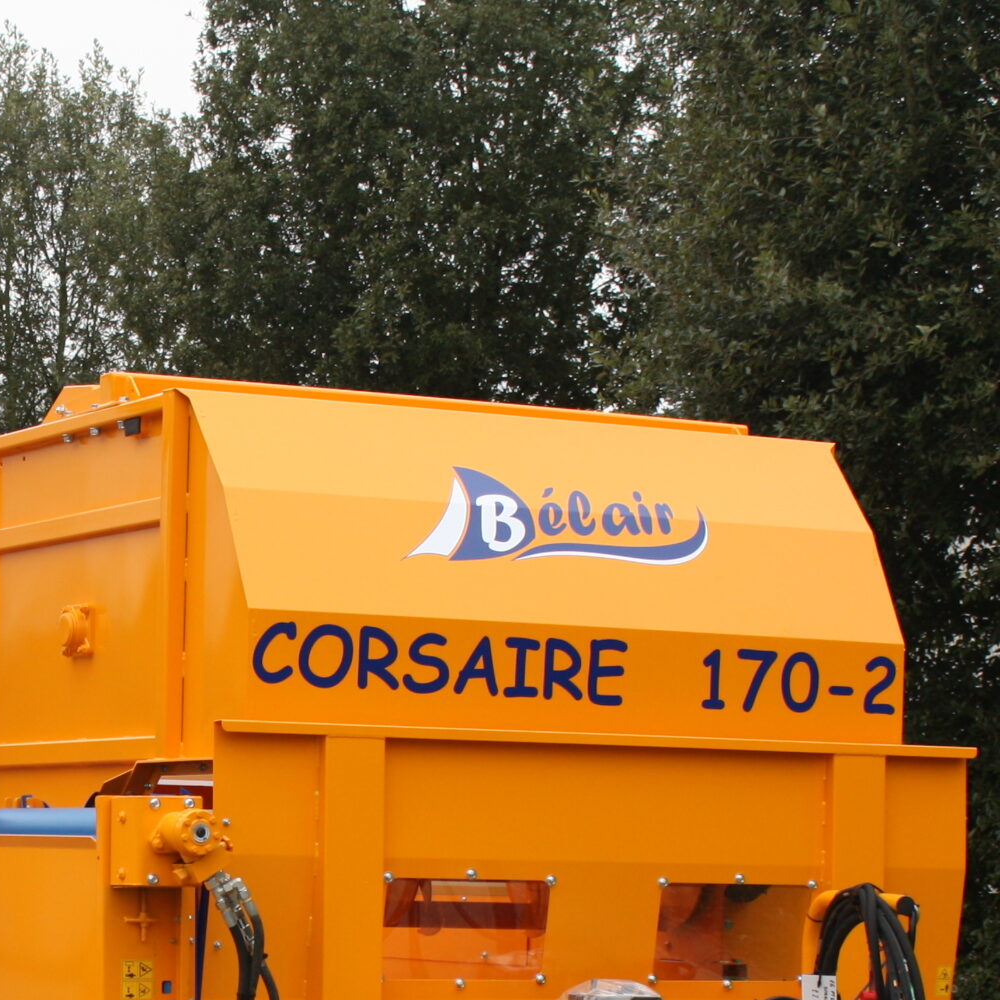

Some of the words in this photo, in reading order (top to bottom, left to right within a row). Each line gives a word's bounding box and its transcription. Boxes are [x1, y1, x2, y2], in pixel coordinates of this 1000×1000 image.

[475, 485, 674, 552] Bélair
[252, 621, 628, 707] CORSAIRE
[701, 648, 898, 716] 170-2
